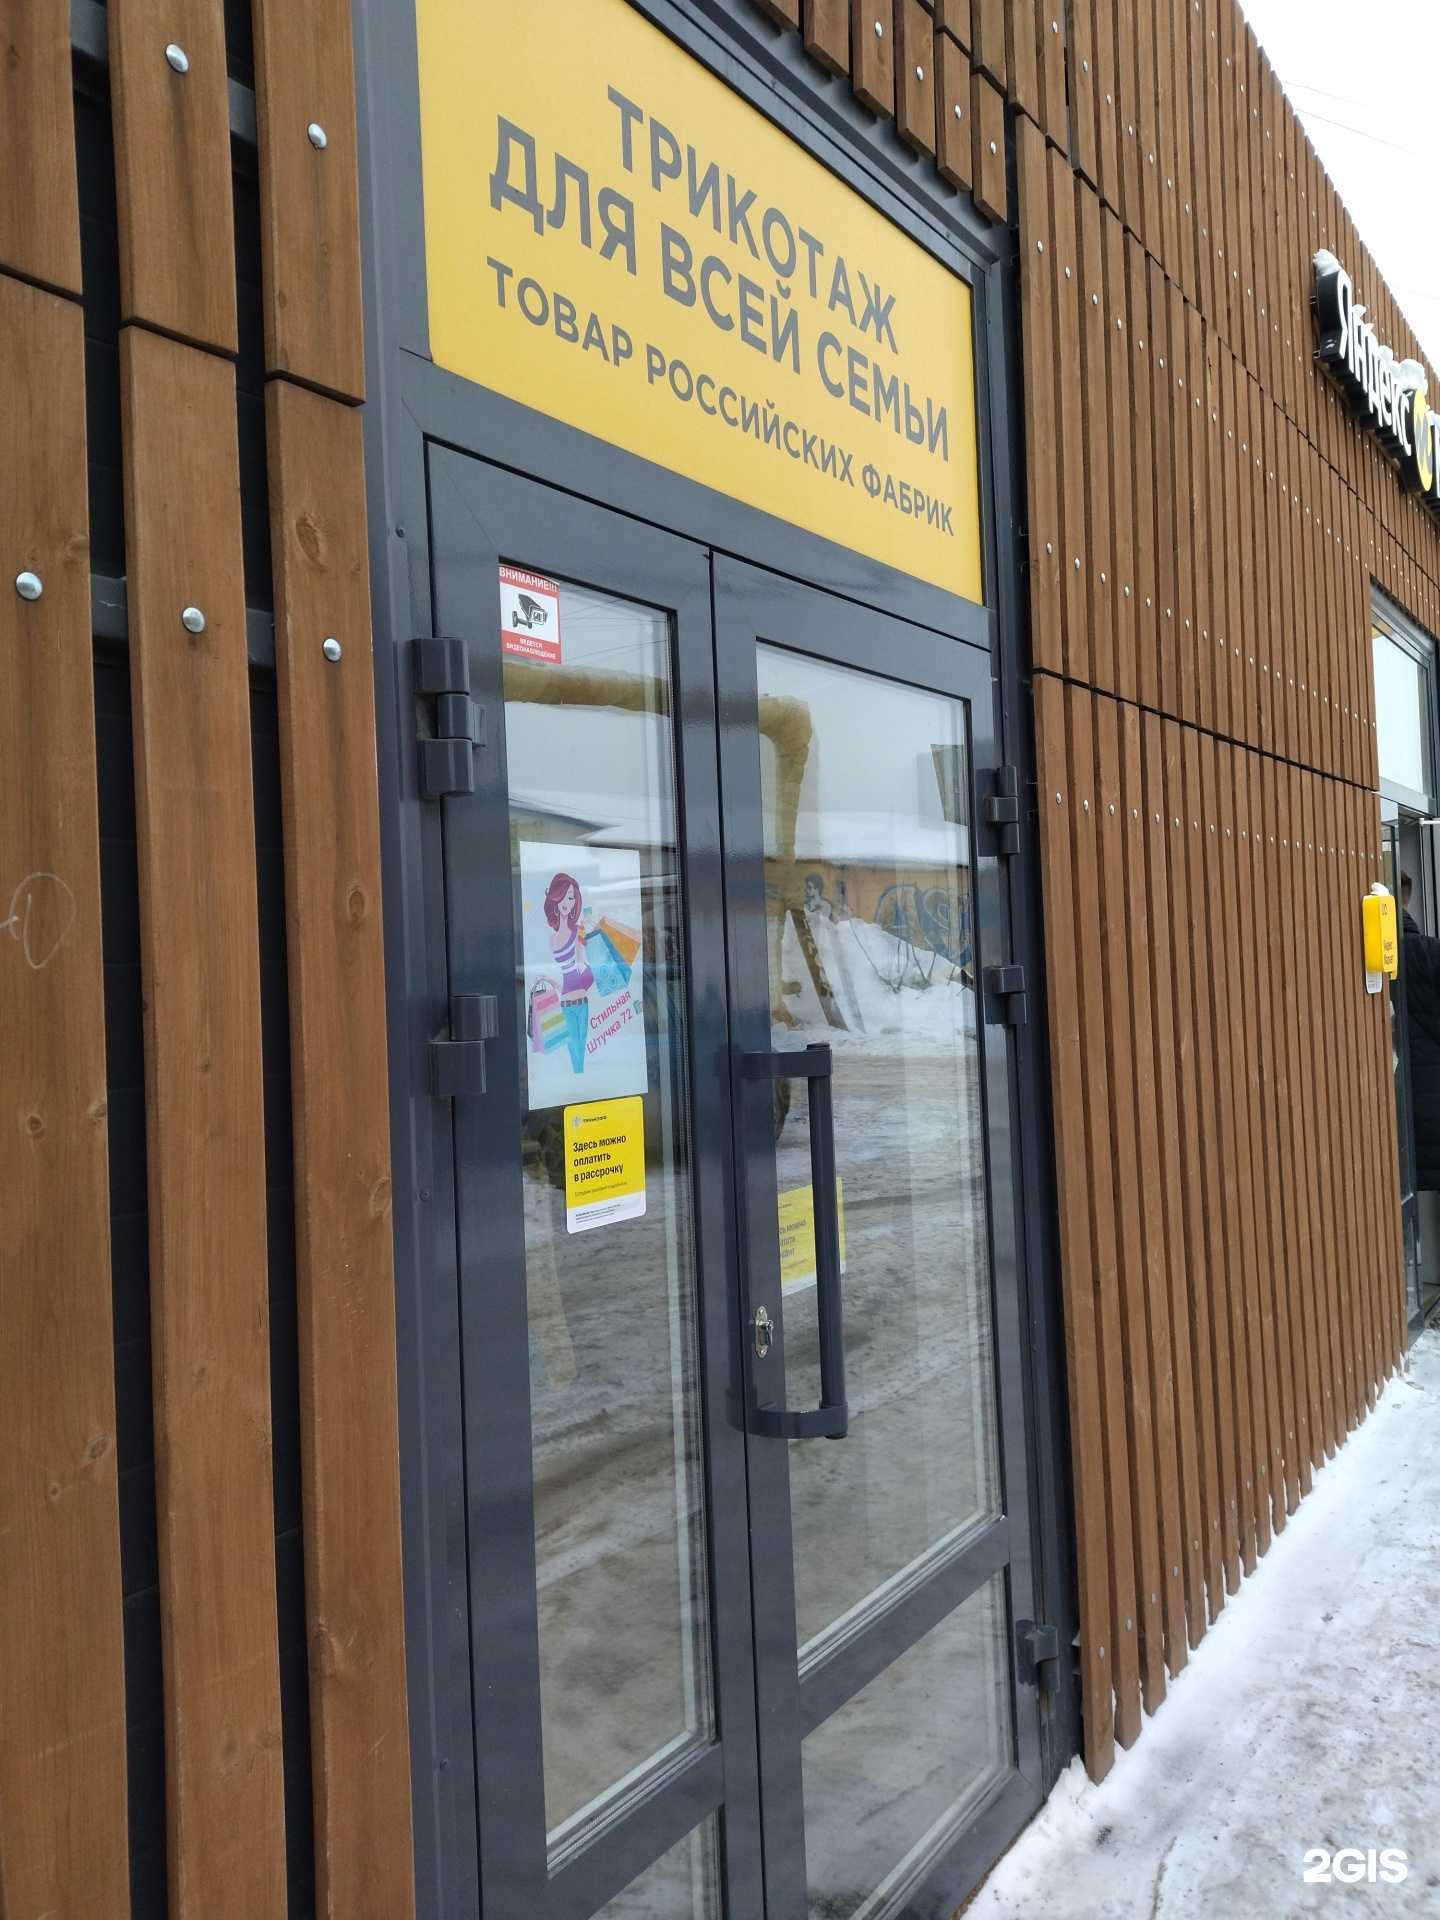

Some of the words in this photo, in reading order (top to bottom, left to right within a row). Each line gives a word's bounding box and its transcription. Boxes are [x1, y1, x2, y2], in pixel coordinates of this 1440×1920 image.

[607, 85, 898, 354] ТРИКОТАЖ
[489, 114, 637, 277] ДЛЯ
[661, 222, 801, 374] ВСЕЙ
[816, 331, 949, 462] СЕМЬИ
[486, 255, 634, 368] ТОВАР
[646, 343, 855, 487] РОССИЙСКИХ
[861, 463, 955, 537] ФАБРИК
[587, 1021, 622, 1054] Штучка
[620, 1008, 633, 1024] 72
[590, 991, 631, 1029] Стильная
[573, 1140, 598, 1153] Здесь
[599, 1134, 627, 1148] можно
[573, 1152, 611, 1168] оплатить
[574, 1172, 580, 1183] в
[580, 1163, 624, 1183] рассрочку
